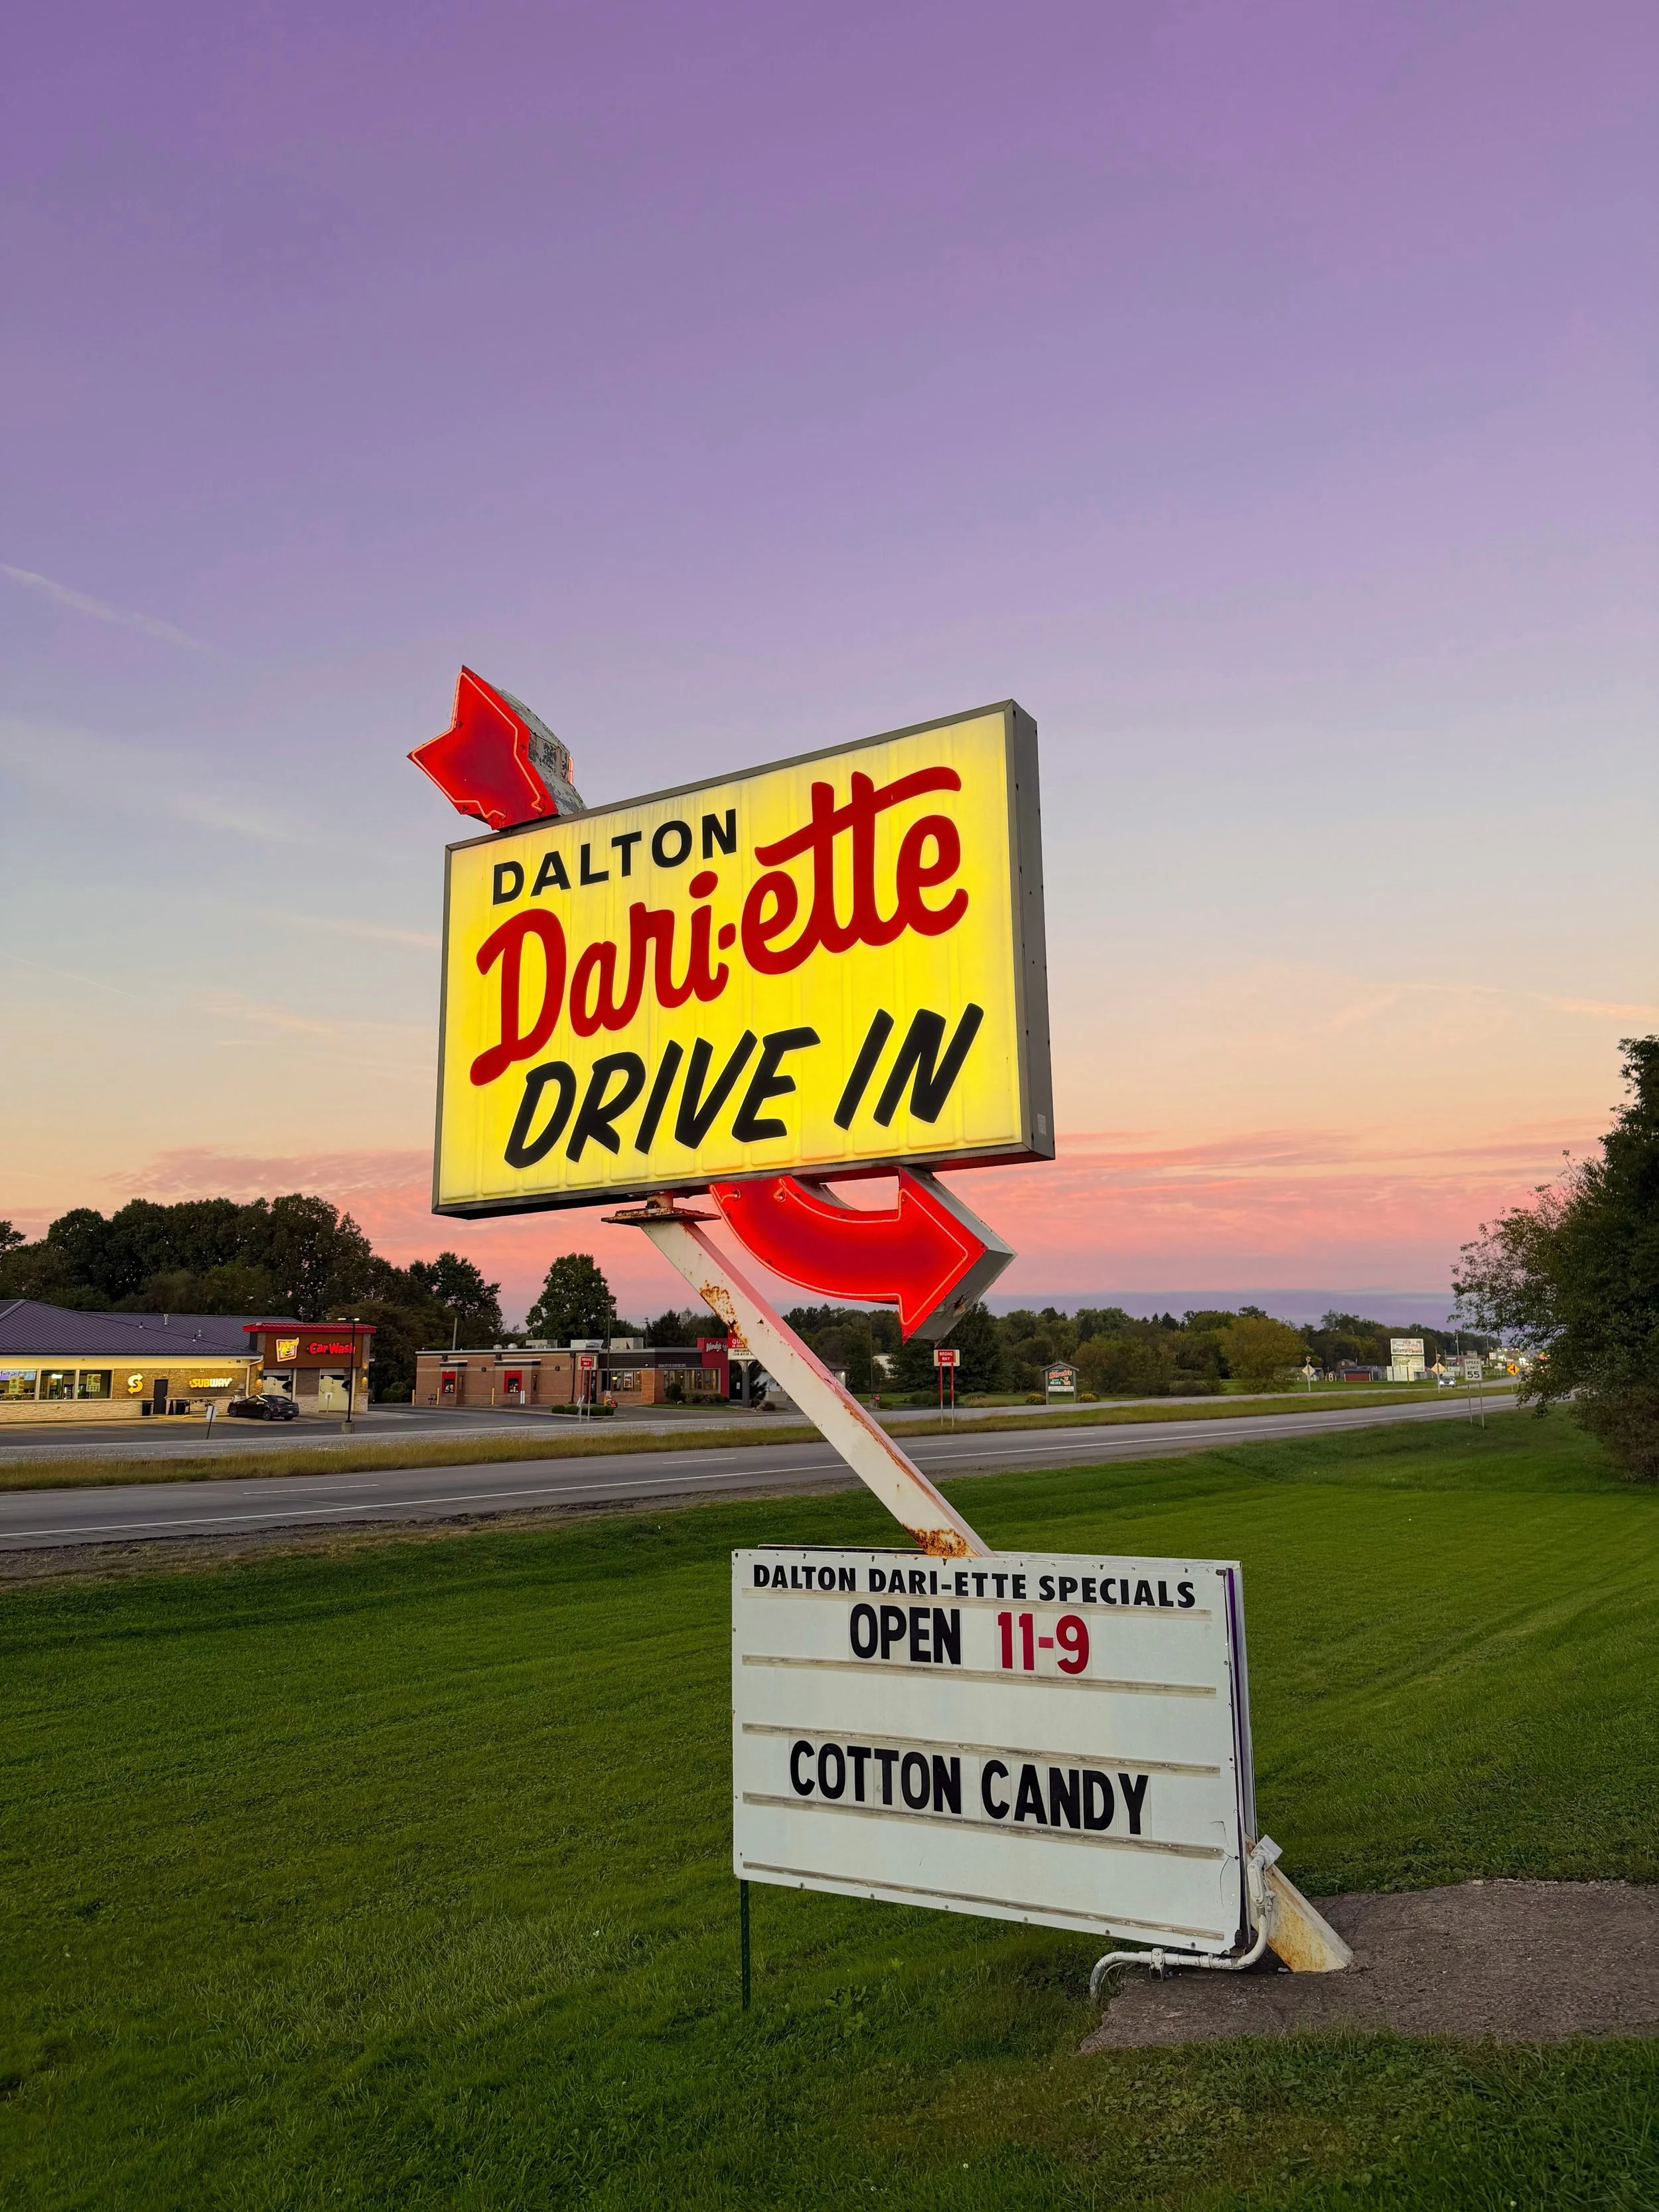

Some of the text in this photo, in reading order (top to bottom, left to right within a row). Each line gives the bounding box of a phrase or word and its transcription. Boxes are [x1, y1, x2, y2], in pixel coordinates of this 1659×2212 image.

[492, 808, 737, 905] DALTON
[470, 766, 969, 1086] Dari-ette
[504, 1003, 984, 1169] DRIVE IN
[309, 1343, 356, 1355] Car Wash
[706, 1341, 722, 1352] Wendy's
[190, 1377, 232, 1388] SUBWAY
[753, 1564, 1196, 1609] DALTON DARI-ETTE SPECIALS
[849, 1603, 1090, 1674] OPEN 11-9
[790, 1739, 1149, 1836] COTTON CANDY
